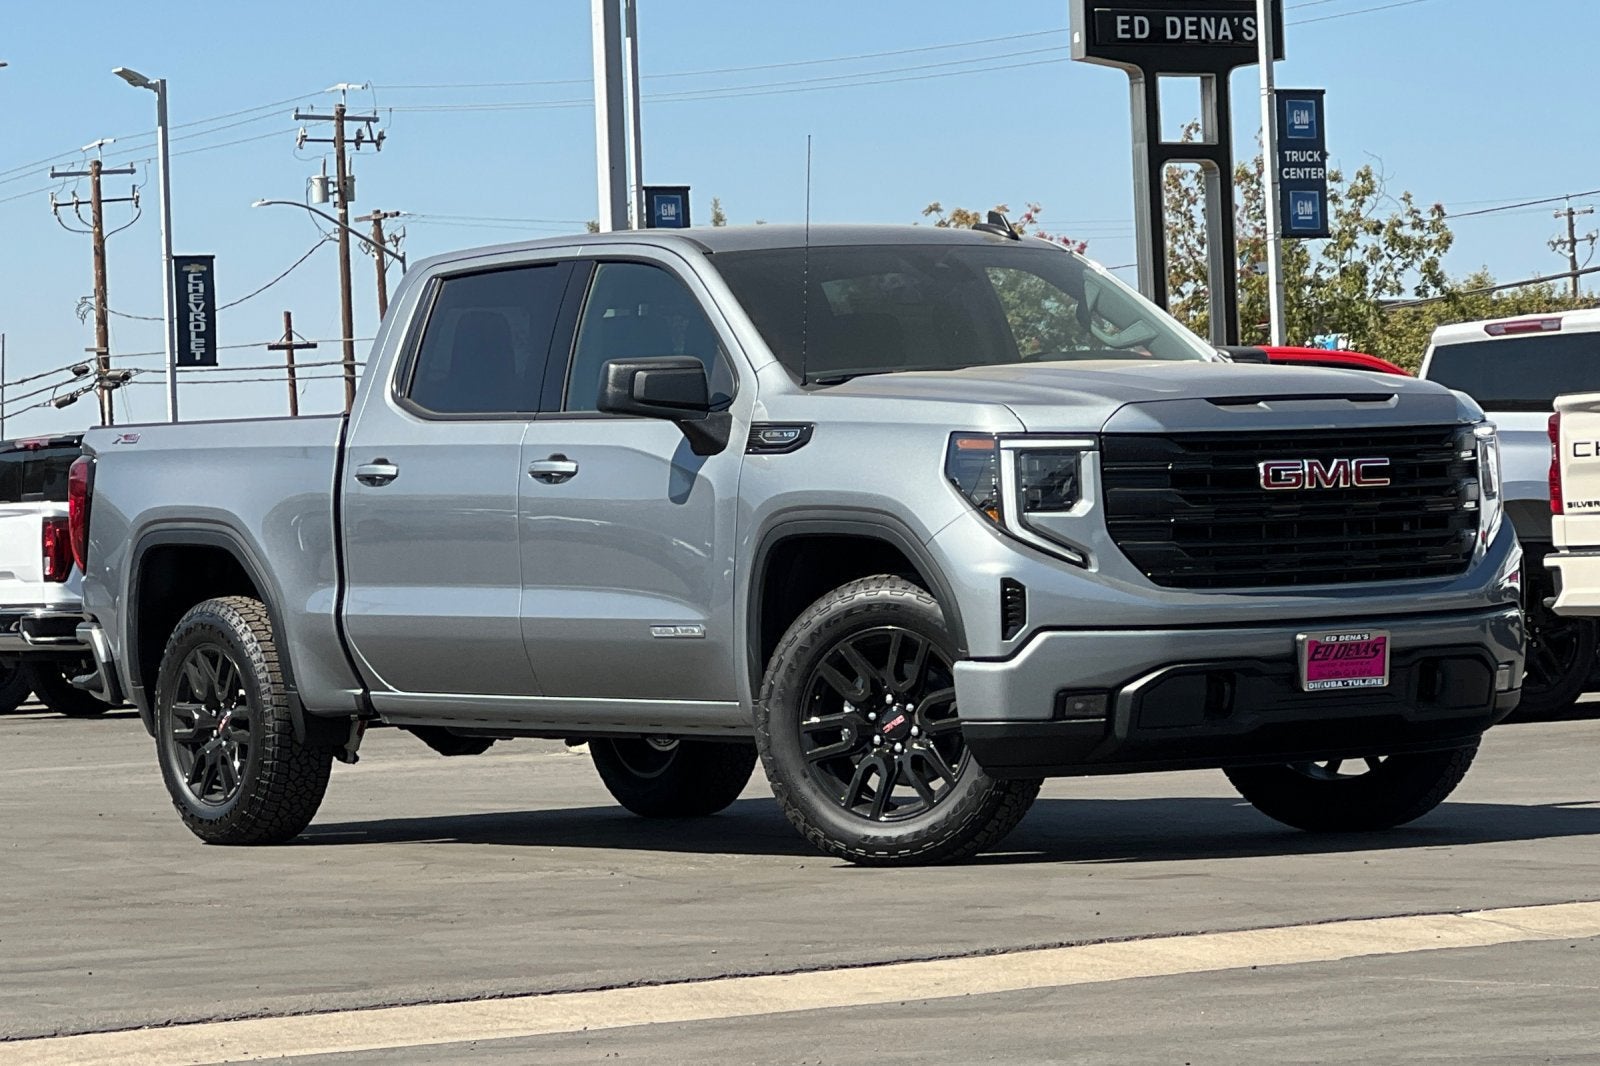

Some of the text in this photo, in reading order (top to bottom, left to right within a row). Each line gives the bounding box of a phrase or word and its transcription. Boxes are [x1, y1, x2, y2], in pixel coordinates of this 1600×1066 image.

[1116, 16, 1257, 41] ED DENA'S
[1293, 110, 1309, 126] GM
[1284, 151, 1321, 163] TRUCK
[1282, 168, 1325, 180] CENTER
[661, 203, 676, 217] GM
[1297, 201, 1313, 216] GM
[187, 273, 207, 360] CHEVROLET
[1258, 458, 1390, 490] GMC
